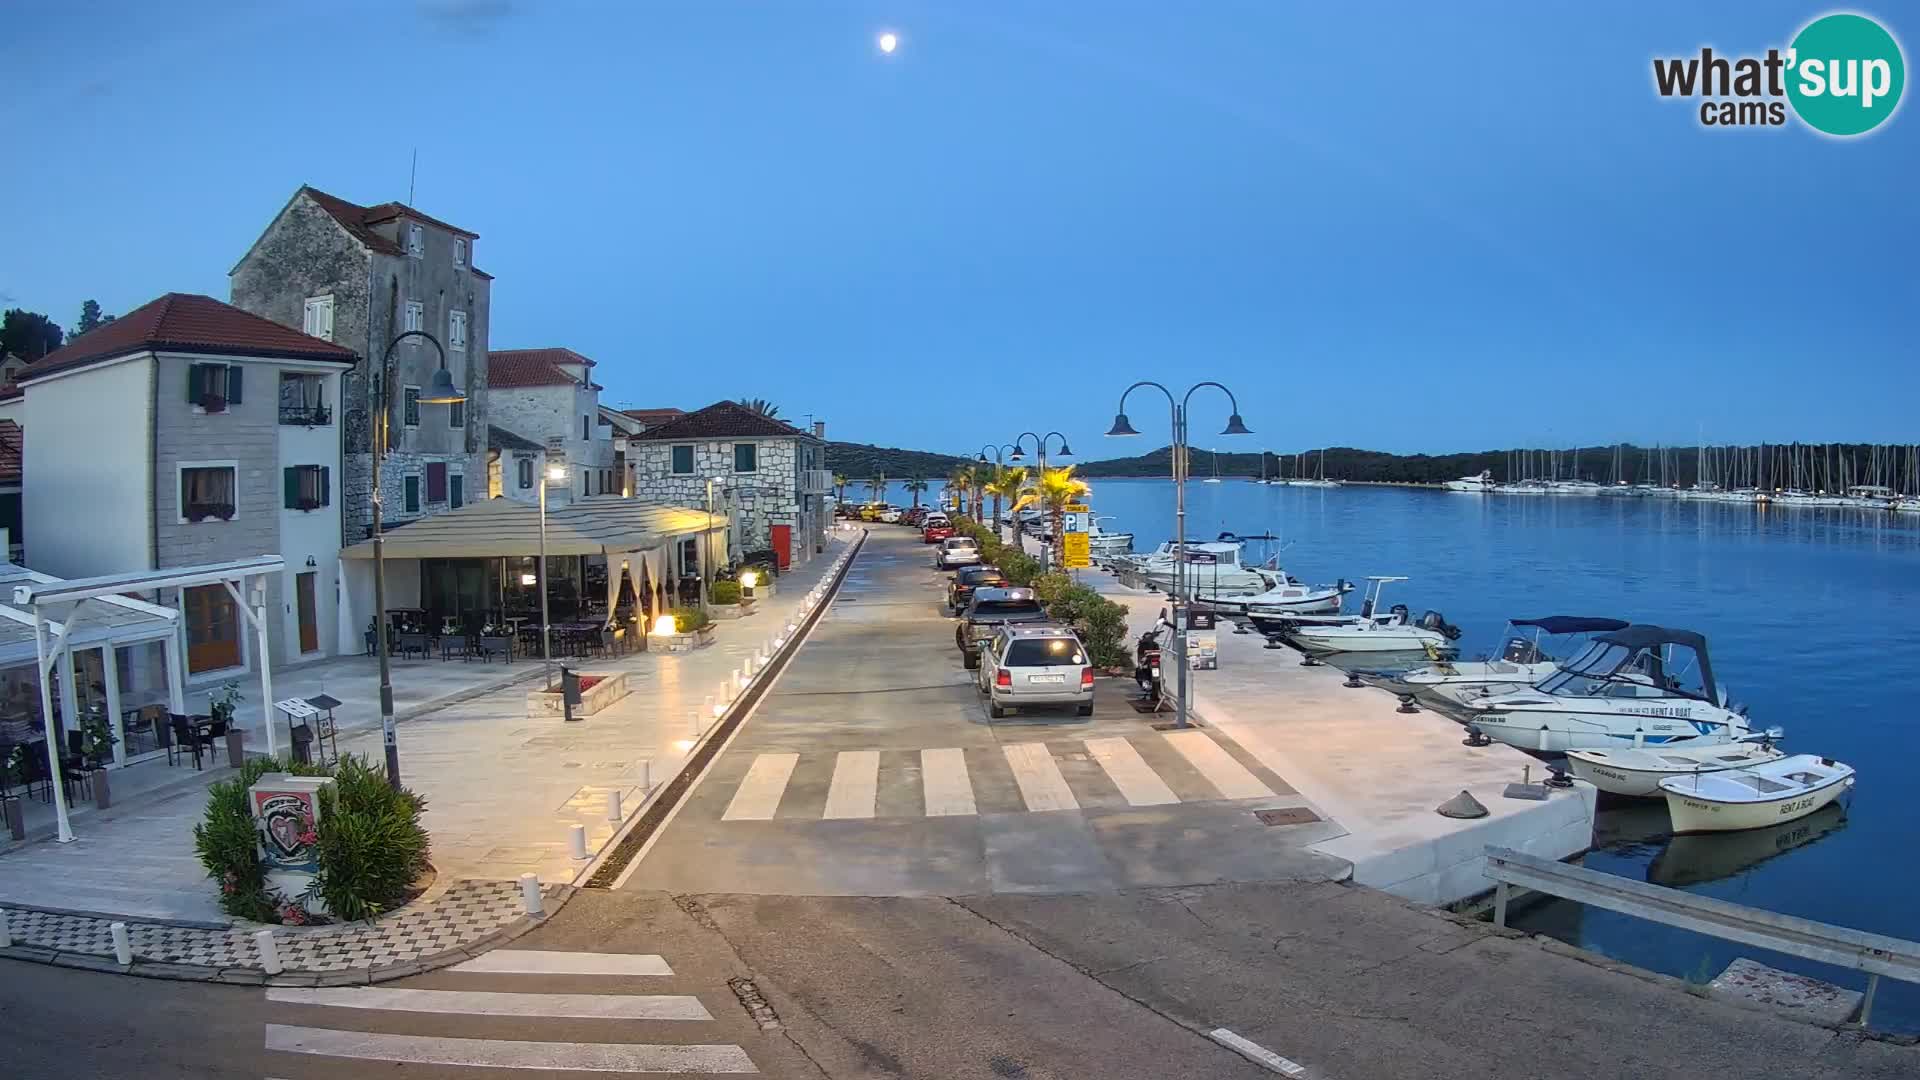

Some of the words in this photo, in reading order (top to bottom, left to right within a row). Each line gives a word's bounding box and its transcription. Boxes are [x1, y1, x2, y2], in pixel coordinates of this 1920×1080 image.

[1065, 514, 1076, 531] P
[1650, 707, 1668, 717] RENT
[1779, 801, 1796, 815] RENT
